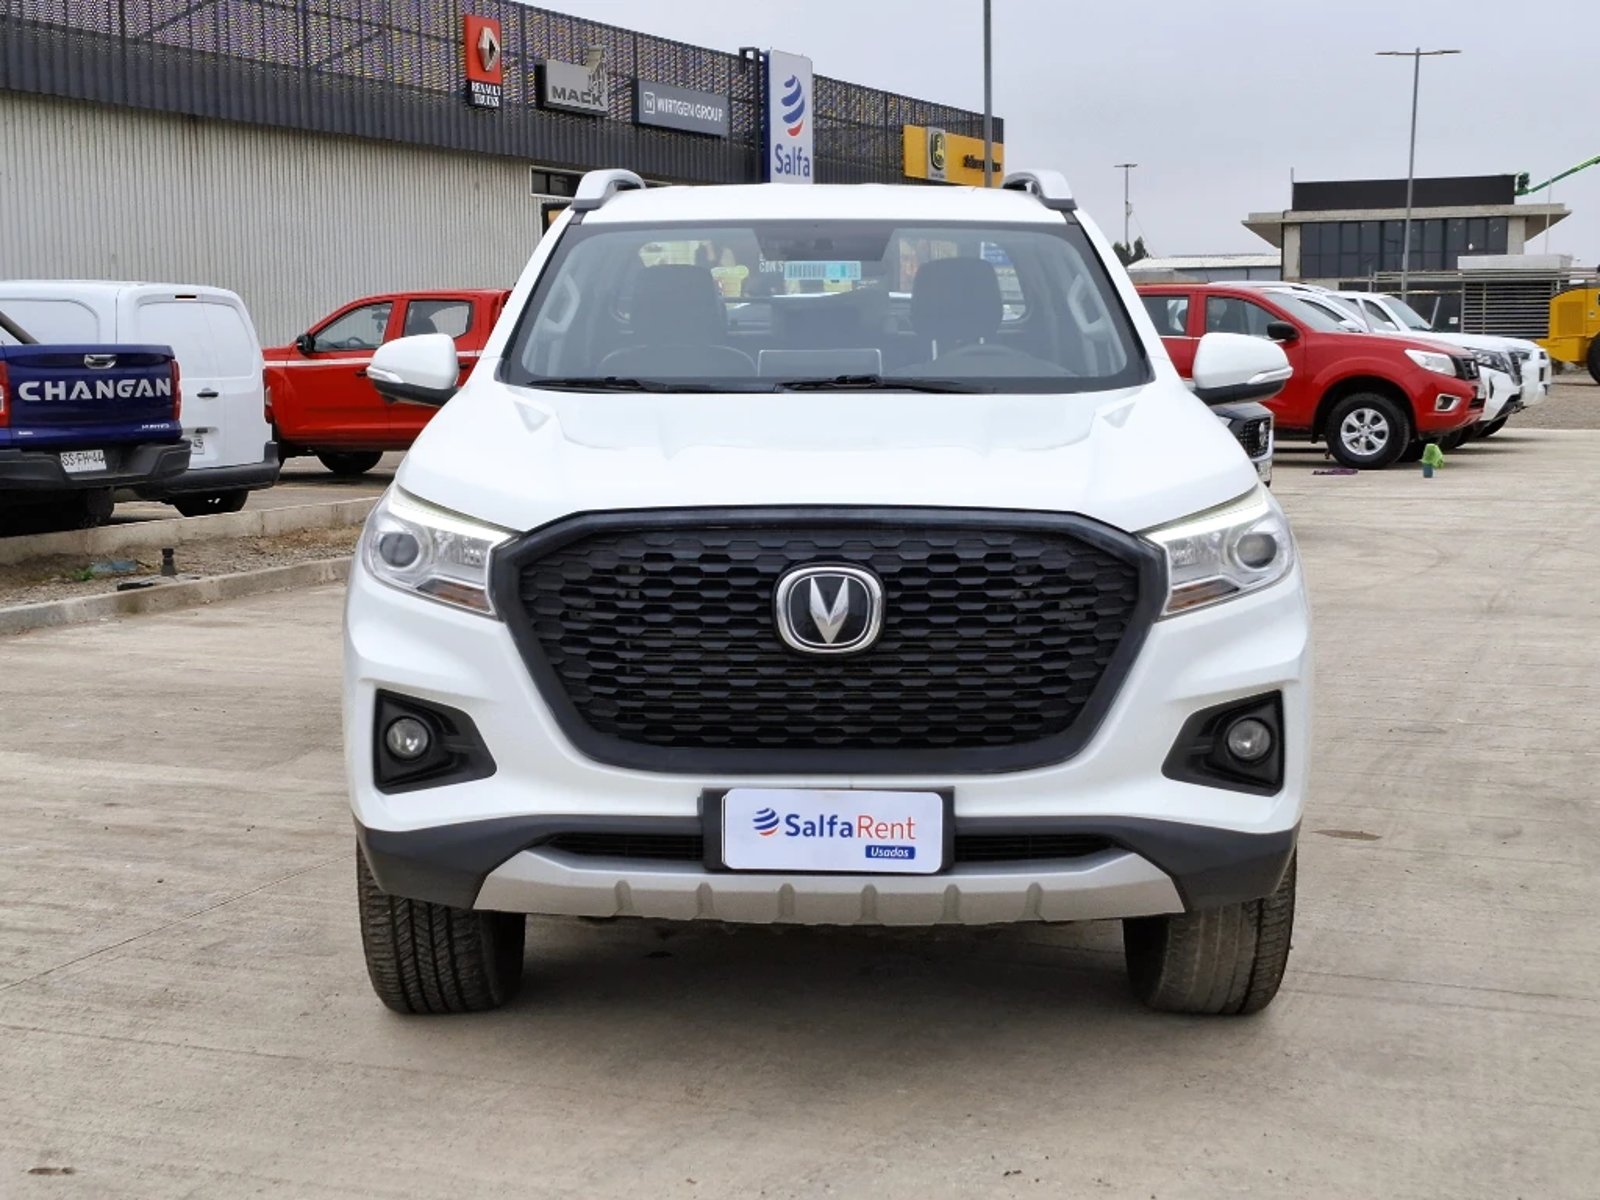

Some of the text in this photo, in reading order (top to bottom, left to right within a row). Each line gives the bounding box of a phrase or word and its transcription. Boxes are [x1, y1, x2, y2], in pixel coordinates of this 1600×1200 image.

[552, 86, 604, 107] MACK
[695, 104, 723, 122] GROUP
[775, 143, 810, 177] Salfa
[18, 378, 171, 400] CHANGAN
[871, 847, 909, 858] Usados
